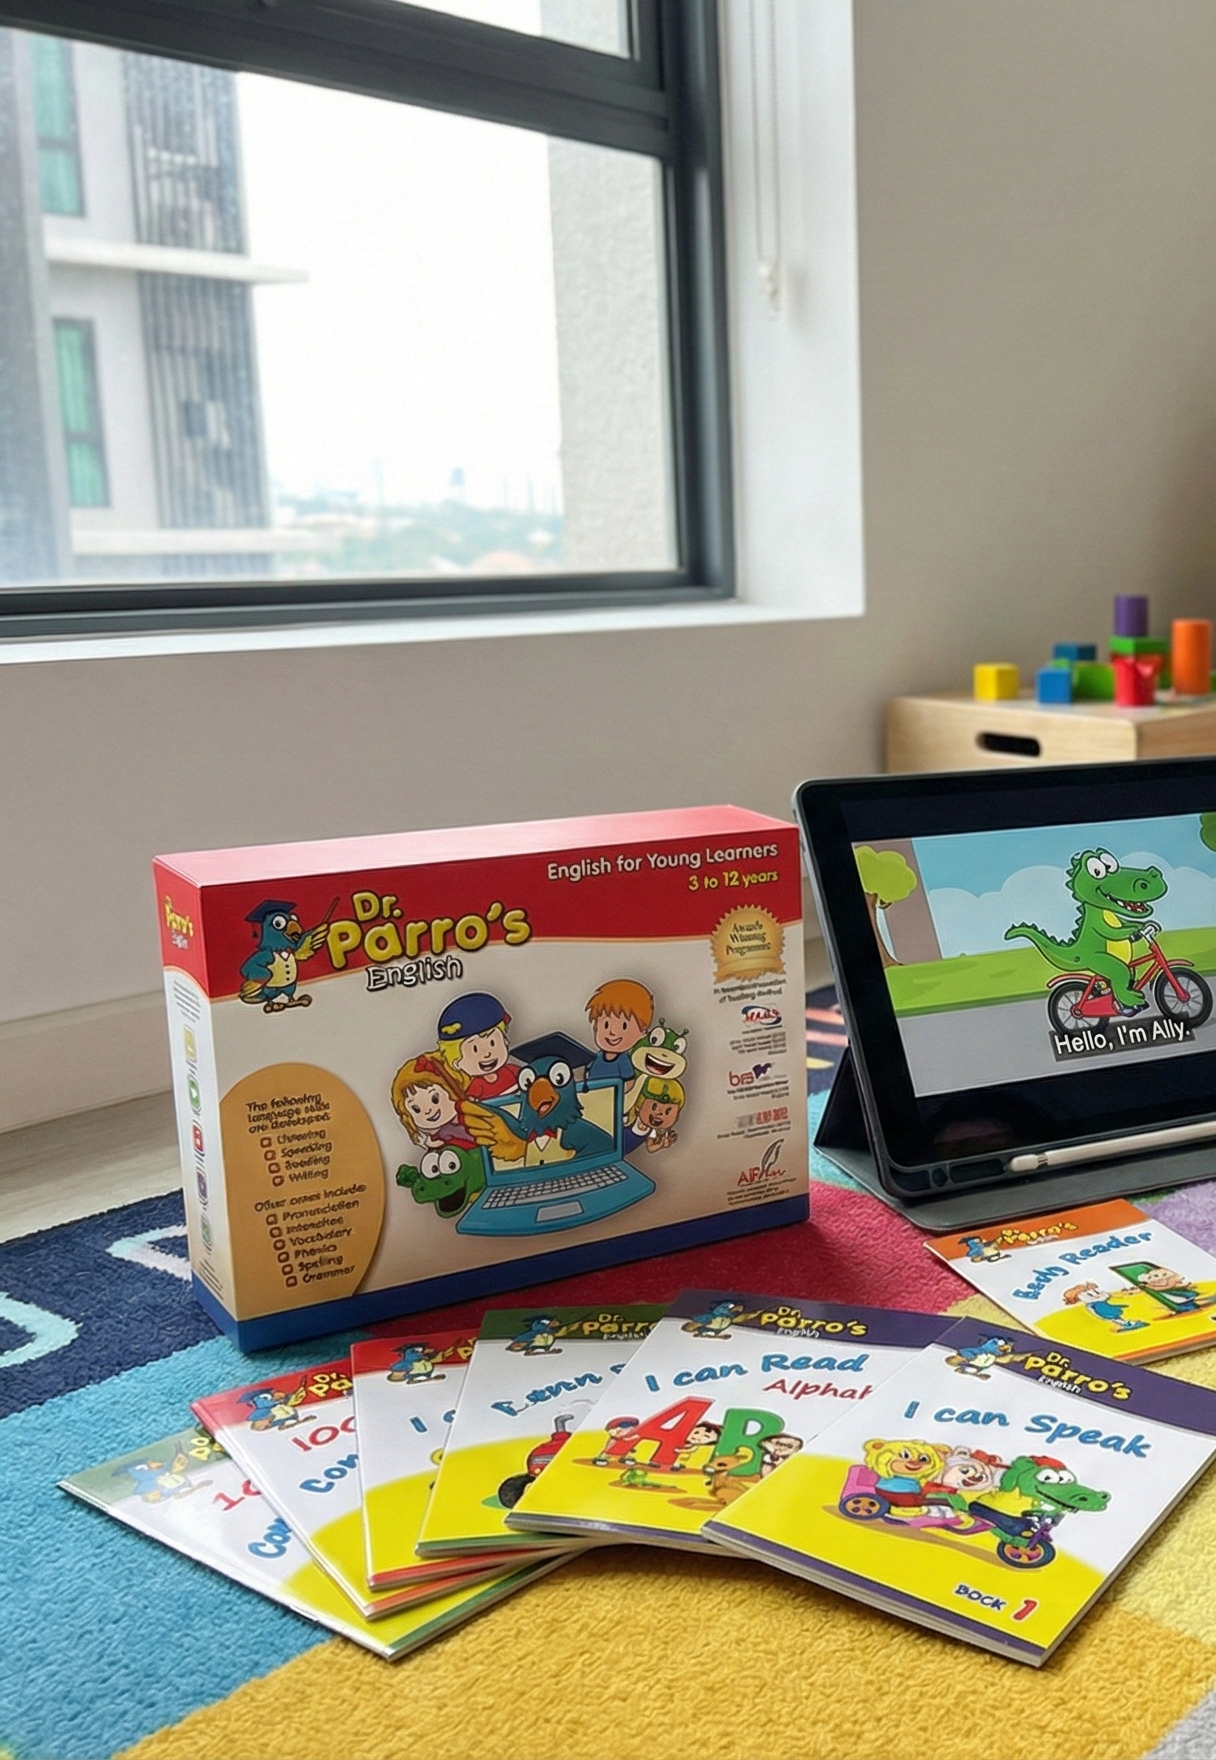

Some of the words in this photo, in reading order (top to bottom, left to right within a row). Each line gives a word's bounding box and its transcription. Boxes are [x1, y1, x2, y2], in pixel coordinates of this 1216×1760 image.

[547, 857, 612, 882] English
[616, 855, 643, 872] for
[647, 851, 701, 869] Young
[706, 843, 779, 864] Learners
[688, 876, 699, 891] 3
[703, 876, 719, 889] to
[723, 871, 740, 887] 12
[742, 870, 779, 888] years
[352, 892, 402, 922] Dr.
[326, 902, 531, 969] Parro's
[366, 956, 463, 991] English
[1054, 1032, 1114, 1055] Hello,
[1117, 1025, 1147, 1045] I'm
[1152, 1018, 1191, 1042] Ally.
[1058, 1231, 1153, 1266] Reader
[759, 1312, 868, 1337] Parro's
[645, 1374, 660, 1393] I
[673, 1362, 748, 1387] can
[761, 1353, 870, 1373] Read
[1047, 1350, 1071, 1369] Dr.
[1024, 1356, 1133, 1400] Parro's
[410, 1416, 428, 1434] I
[904, 1400, 920, 1420] I
[933, 1406, 1010, 1427] can
[1024, 1413, 1152, 1458] Speak
[1012, 1599, 1038, 1621] 1
